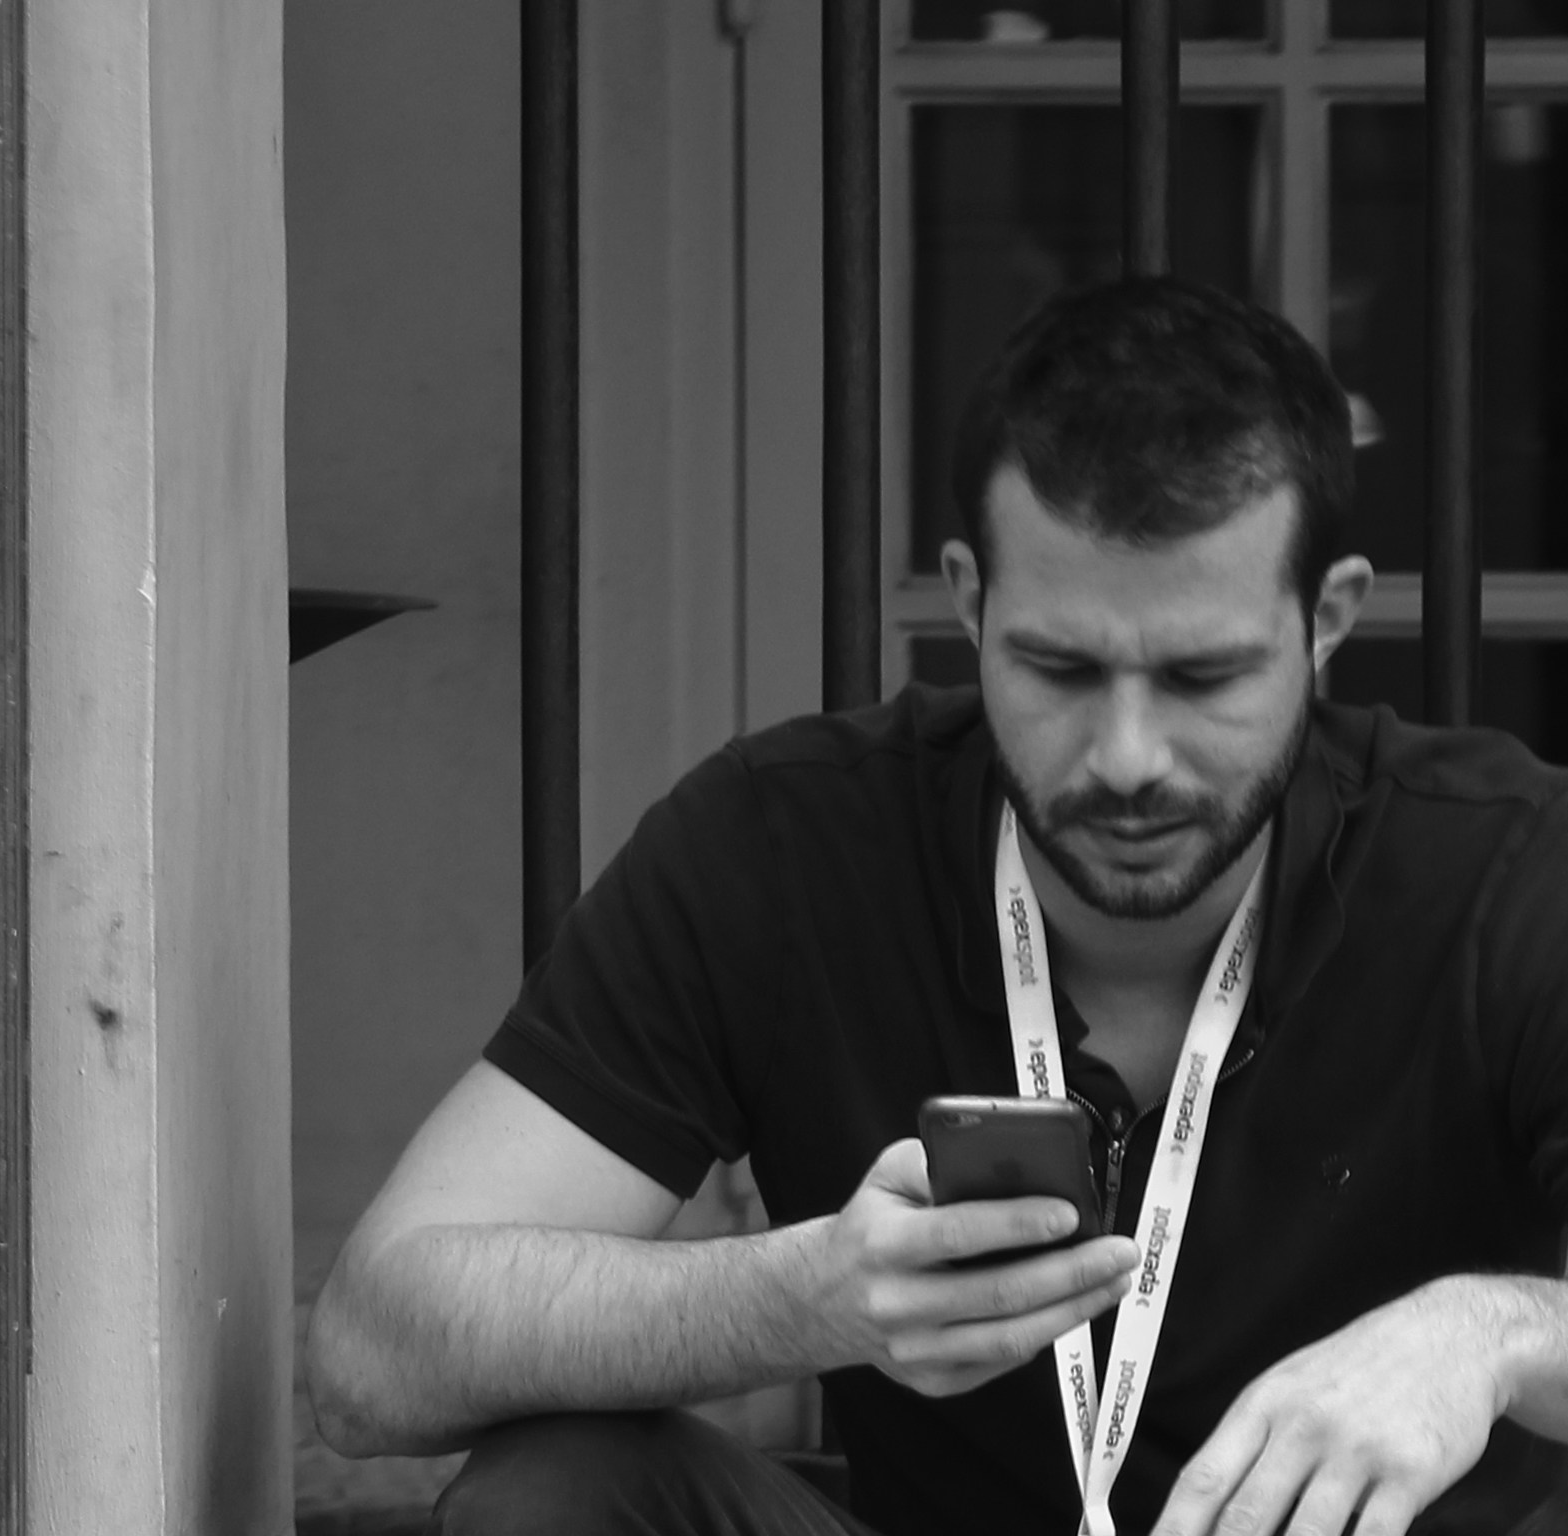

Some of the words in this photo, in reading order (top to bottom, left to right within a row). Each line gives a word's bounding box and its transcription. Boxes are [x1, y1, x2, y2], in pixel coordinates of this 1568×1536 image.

[1027, 1051, 1052, 1099] epex
[1173, 1051, 1209, 1143] epexspot
[1138, 1205, 1172, 1297] epexspot
[1105, 1358, 1138, 1448] epexspot
